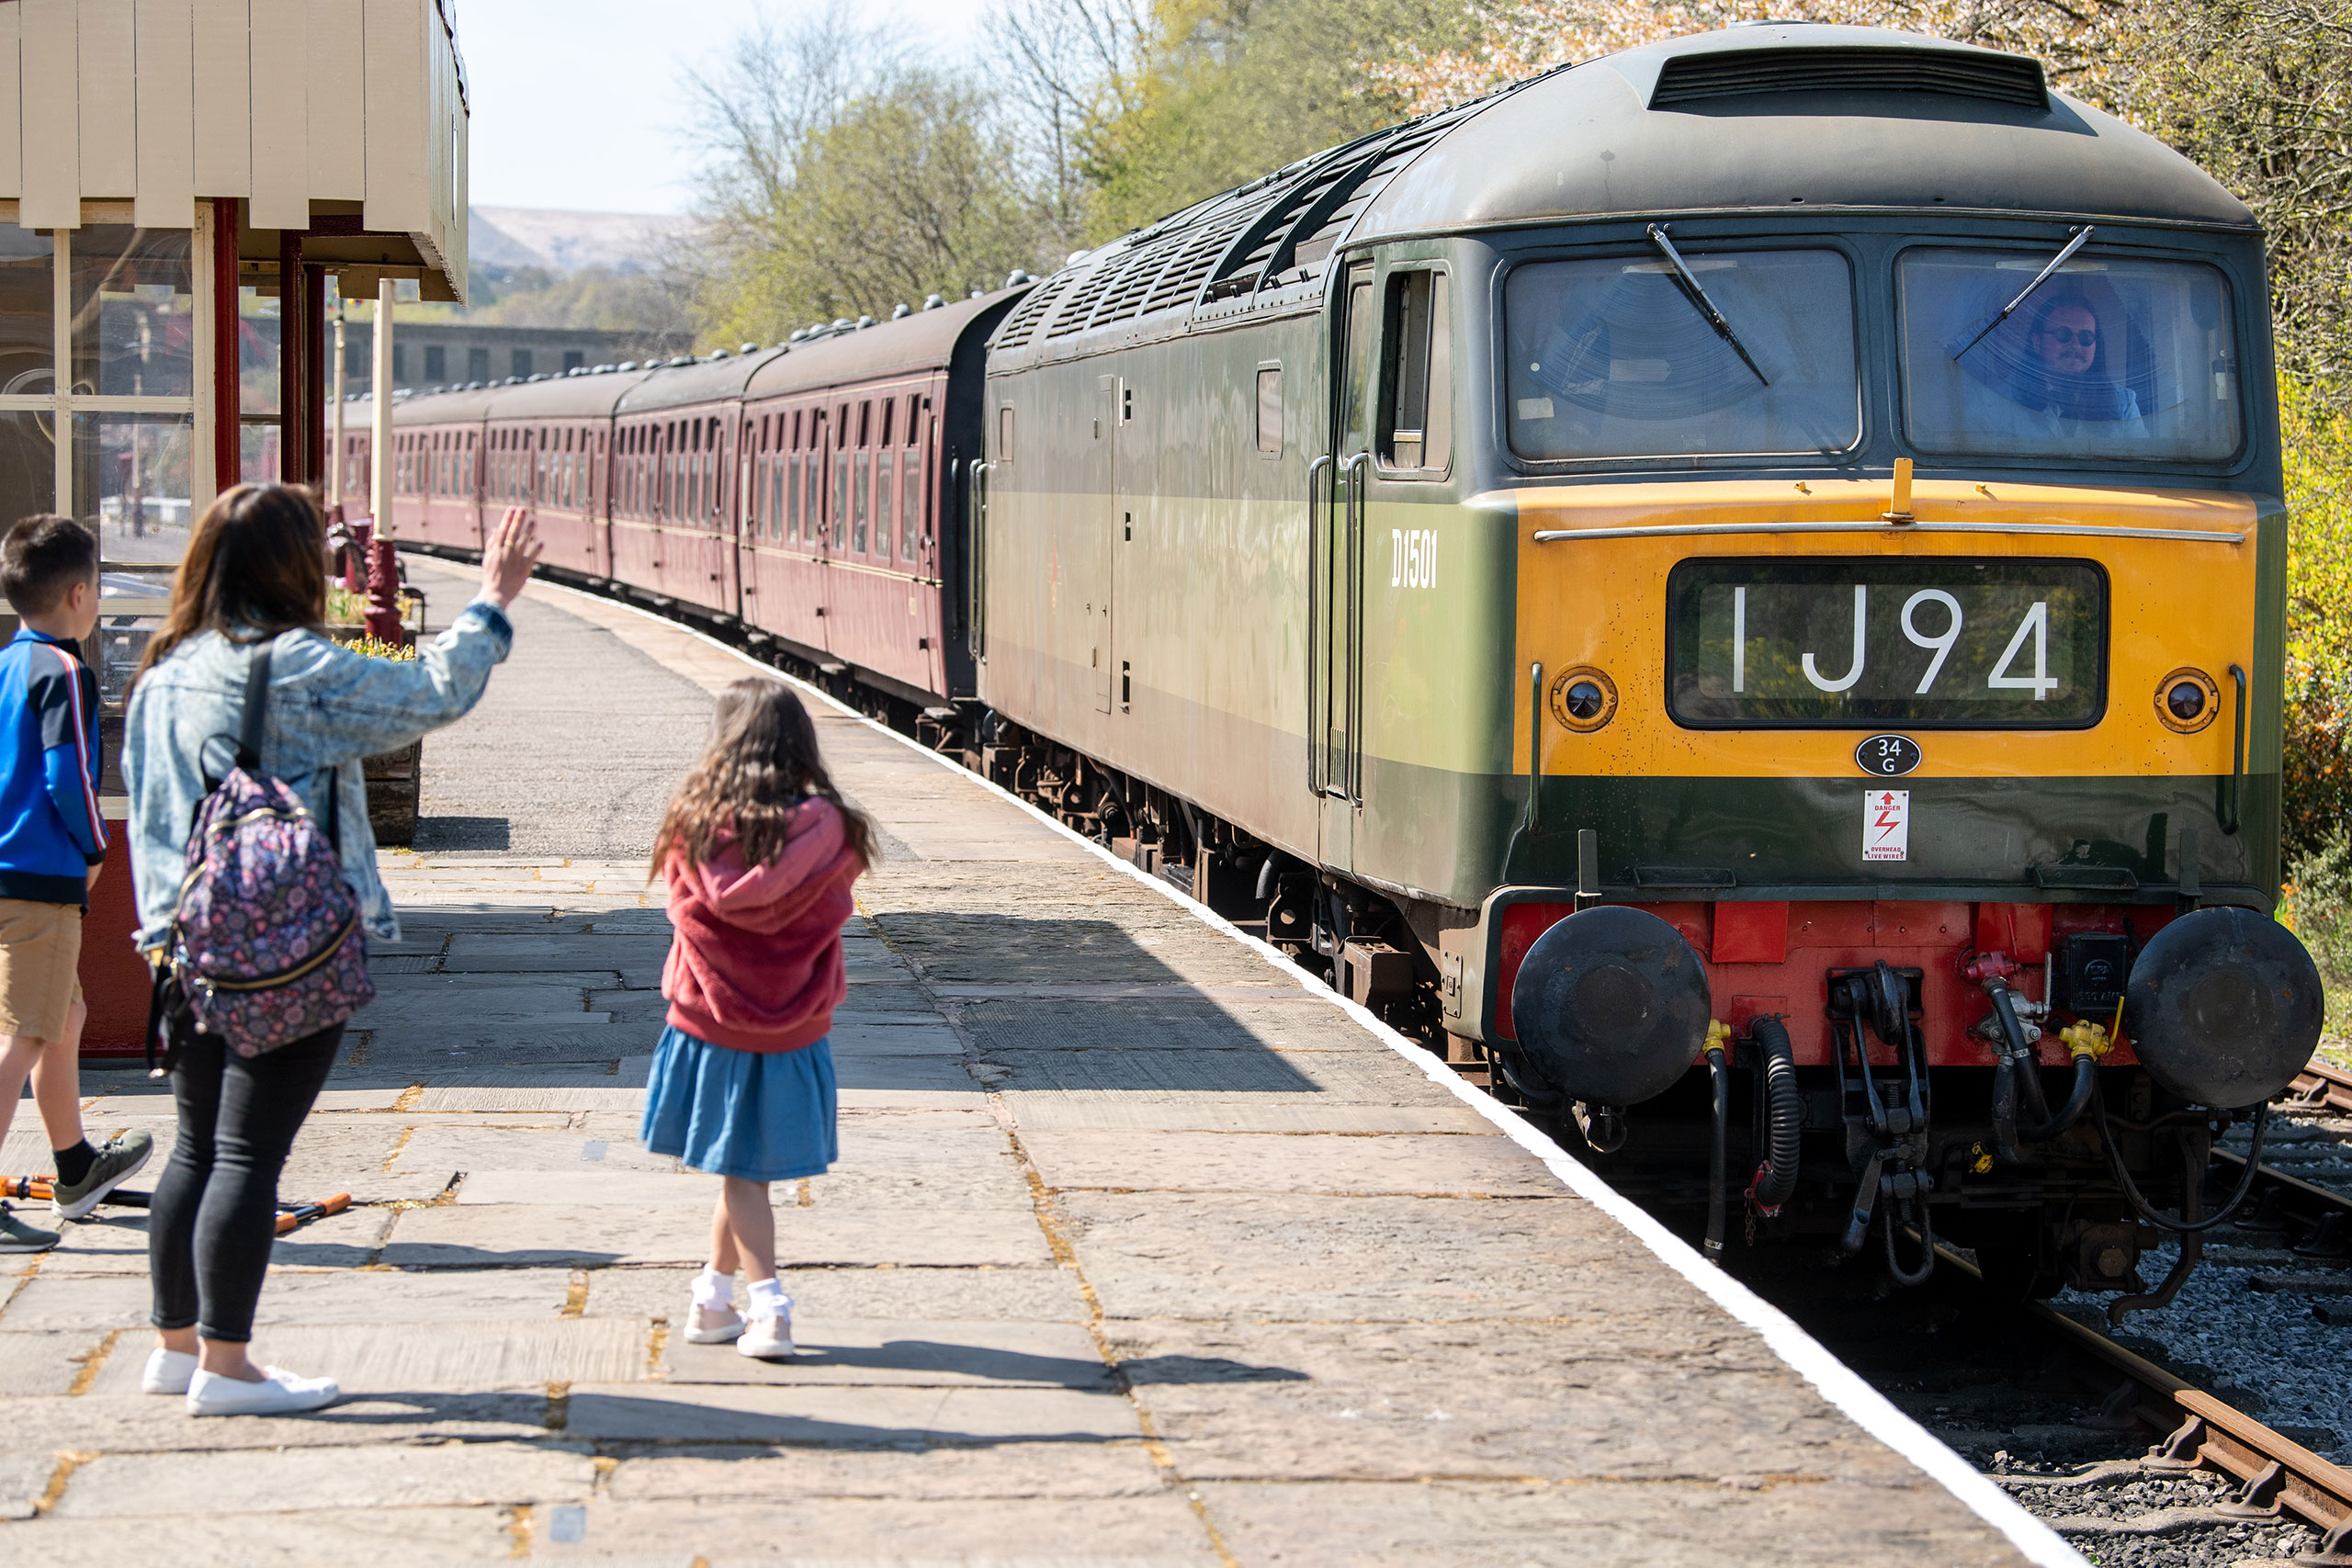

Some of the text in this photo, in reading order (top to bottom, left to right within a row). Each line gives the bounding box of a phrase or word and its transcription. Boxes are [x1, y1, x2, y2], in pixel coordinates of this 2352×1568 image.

[1391, 528, 1438, 589] D1501
[1878, 739, 1902, 757] 34
[1882, 758, 1895, 773] G
